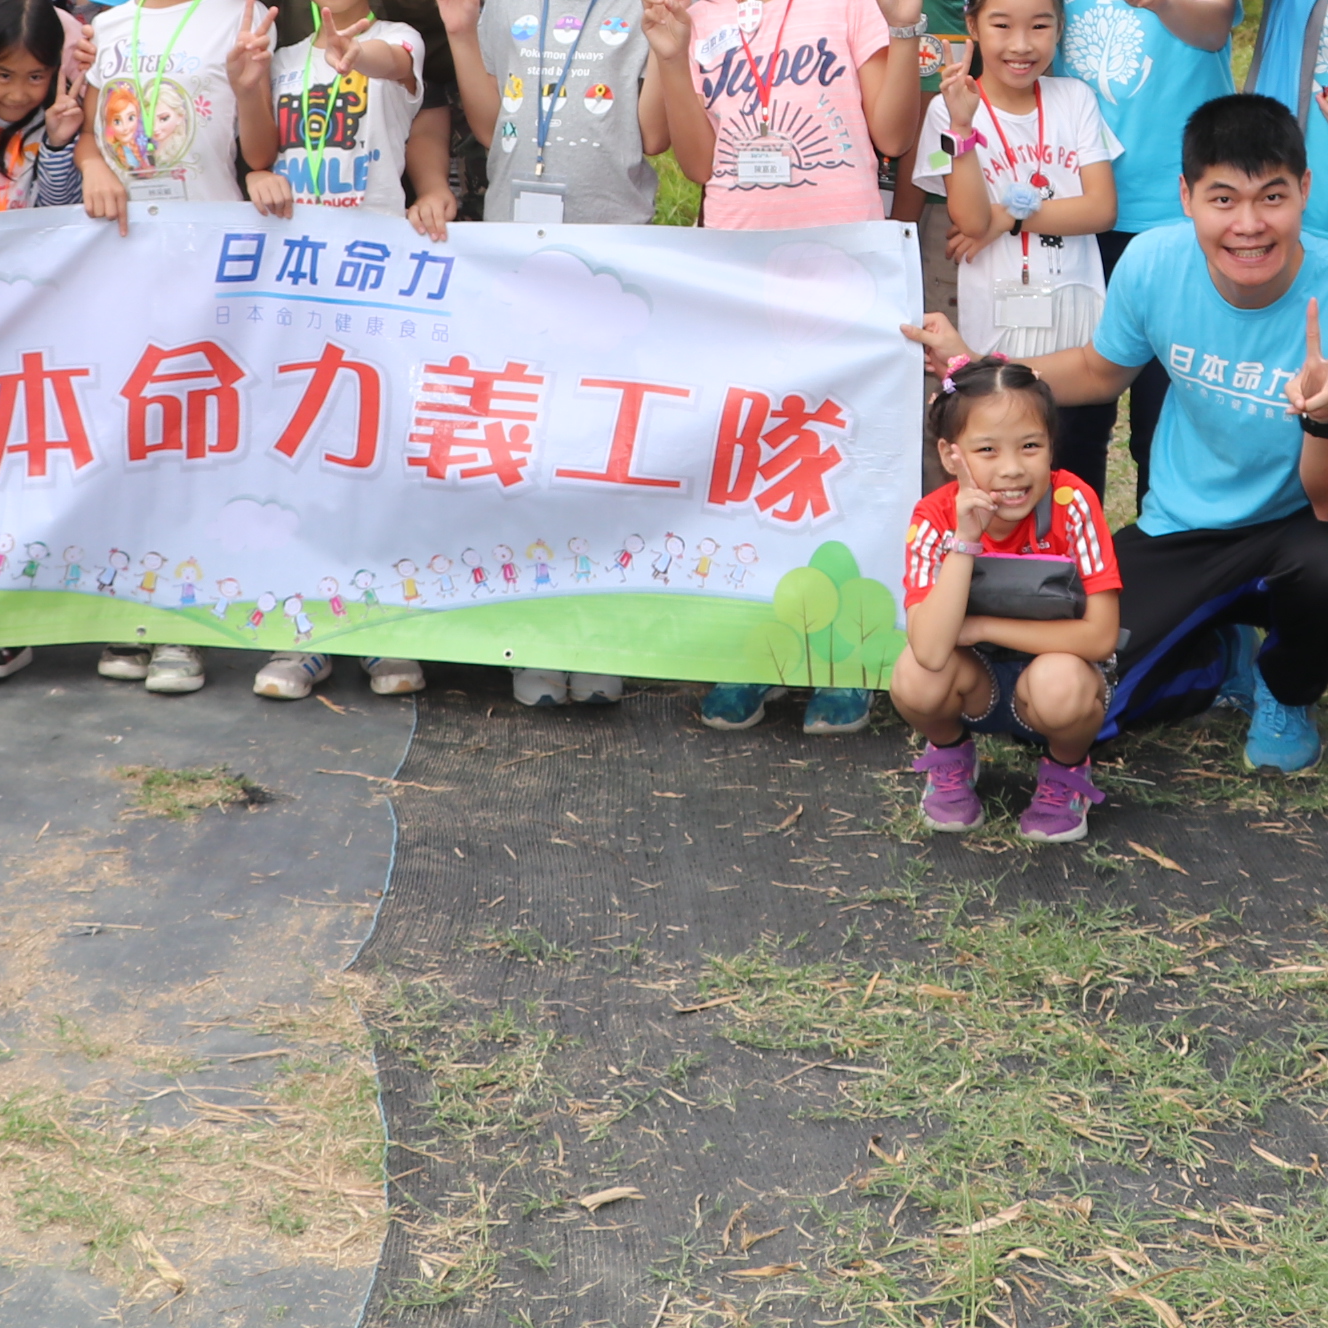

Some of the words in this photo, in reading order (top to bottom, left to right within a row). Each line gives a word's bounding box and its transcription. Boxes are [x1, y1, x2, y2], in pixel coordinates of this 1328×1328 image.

[520, 47, 566, 61] Pokmon
[571, 68, 590, 78] you
[215, 233, 455, 301] 日本命力
[216, 304, 449, 343] 日本命力健康食品
